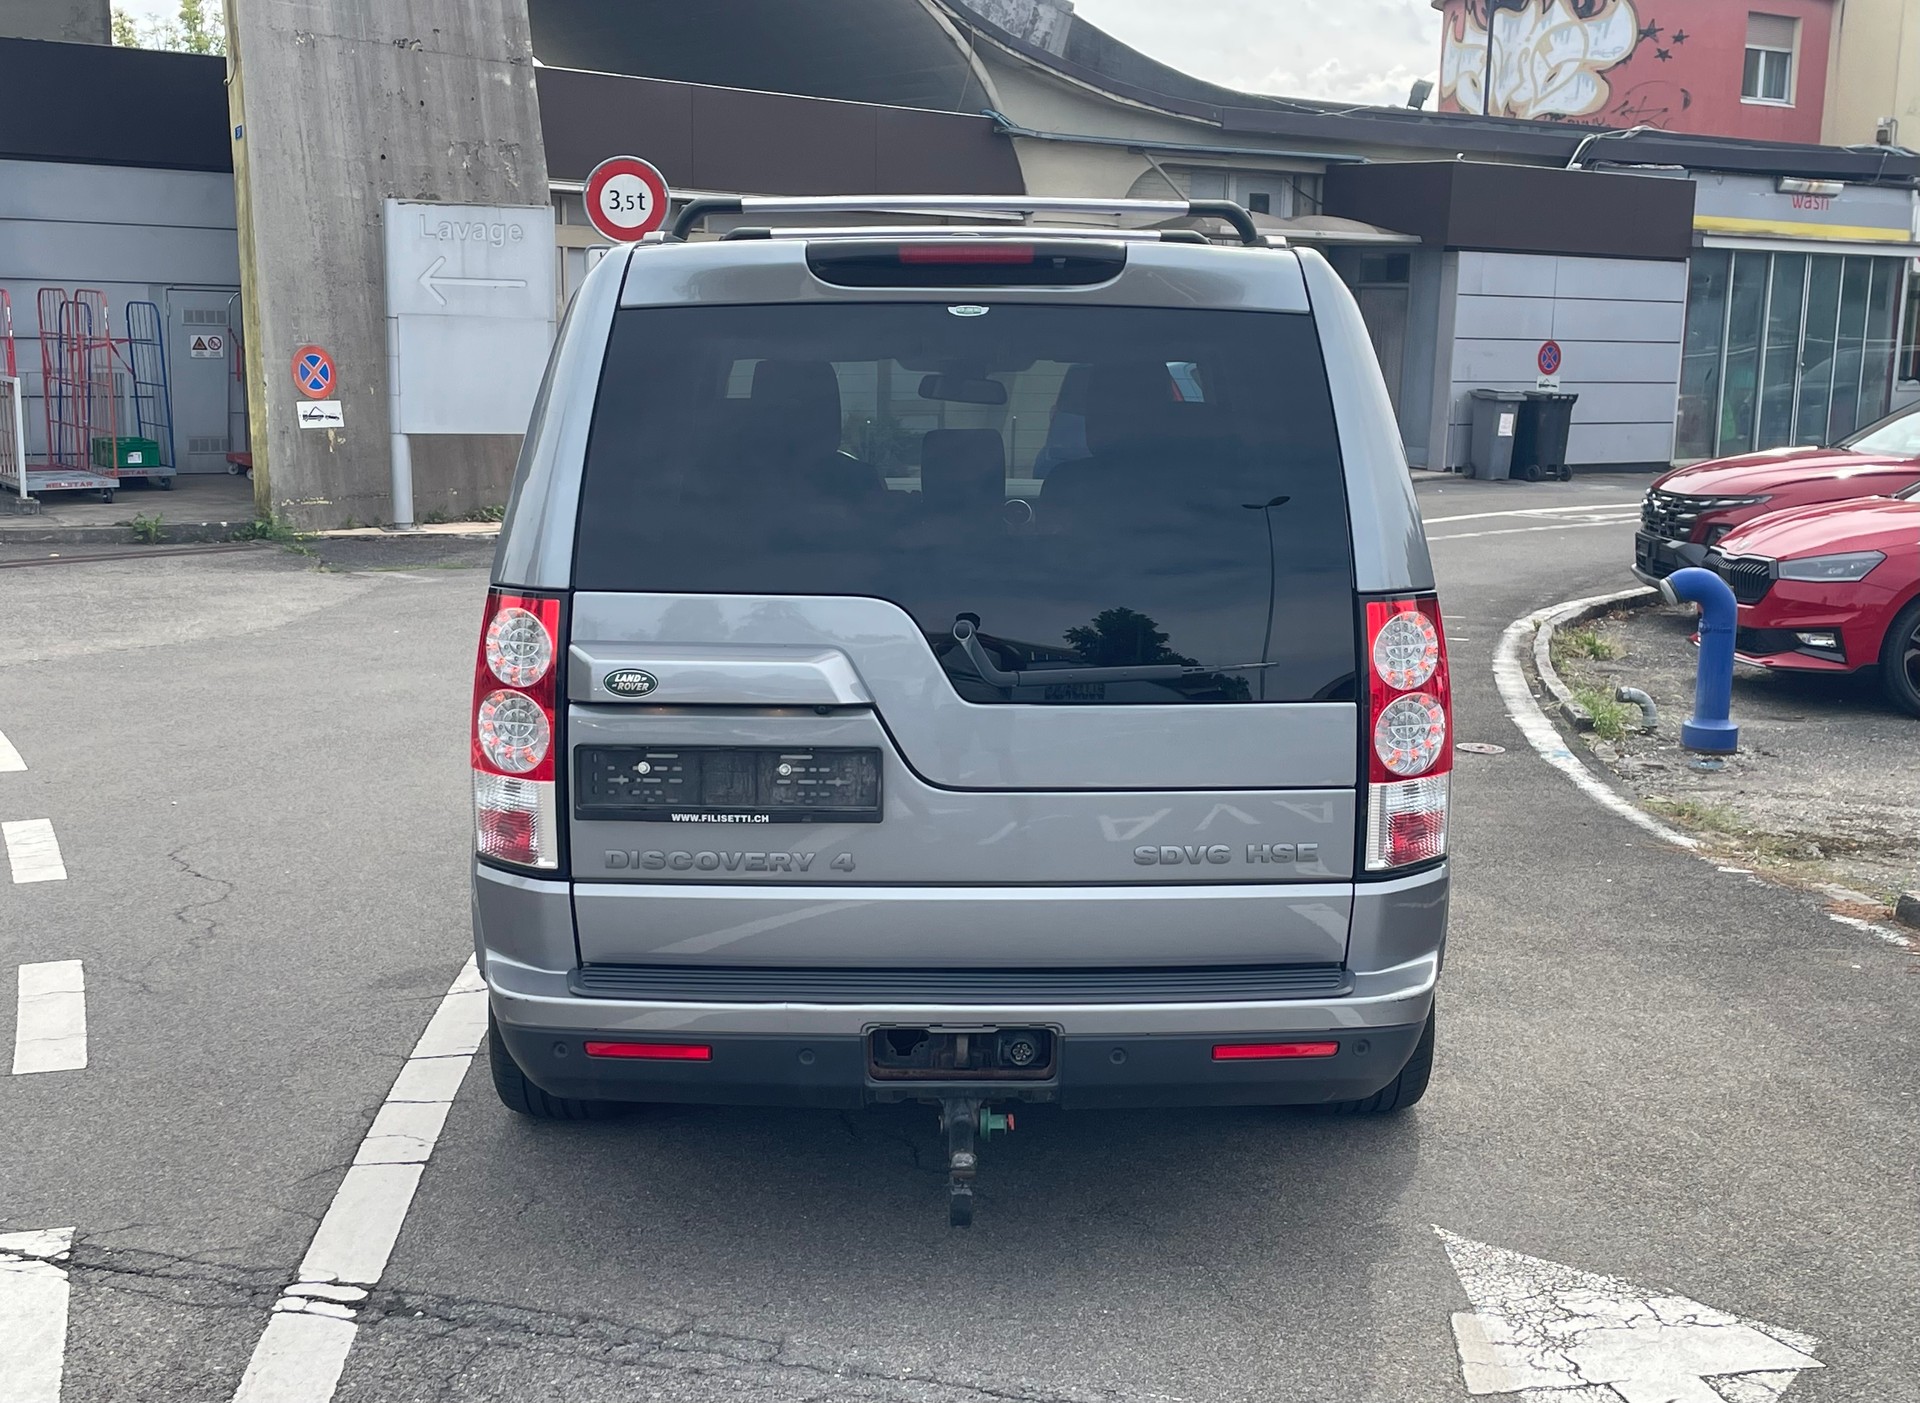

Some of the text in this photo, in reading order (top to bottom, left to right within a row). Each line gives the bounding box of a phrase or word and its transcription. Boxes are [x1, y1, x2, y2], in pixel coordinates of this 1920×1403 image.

[418, 213, 524, 248] Lavage
[614, 674, 642, 682] LAND
[617, 682, 650, 691] ROVER
[671, 813, 770, 823] WWW.FILISETTI.CH
[604, 849, 856, 873] DISCOVERY 4
[1245, 842, 1319, 864] HSE
